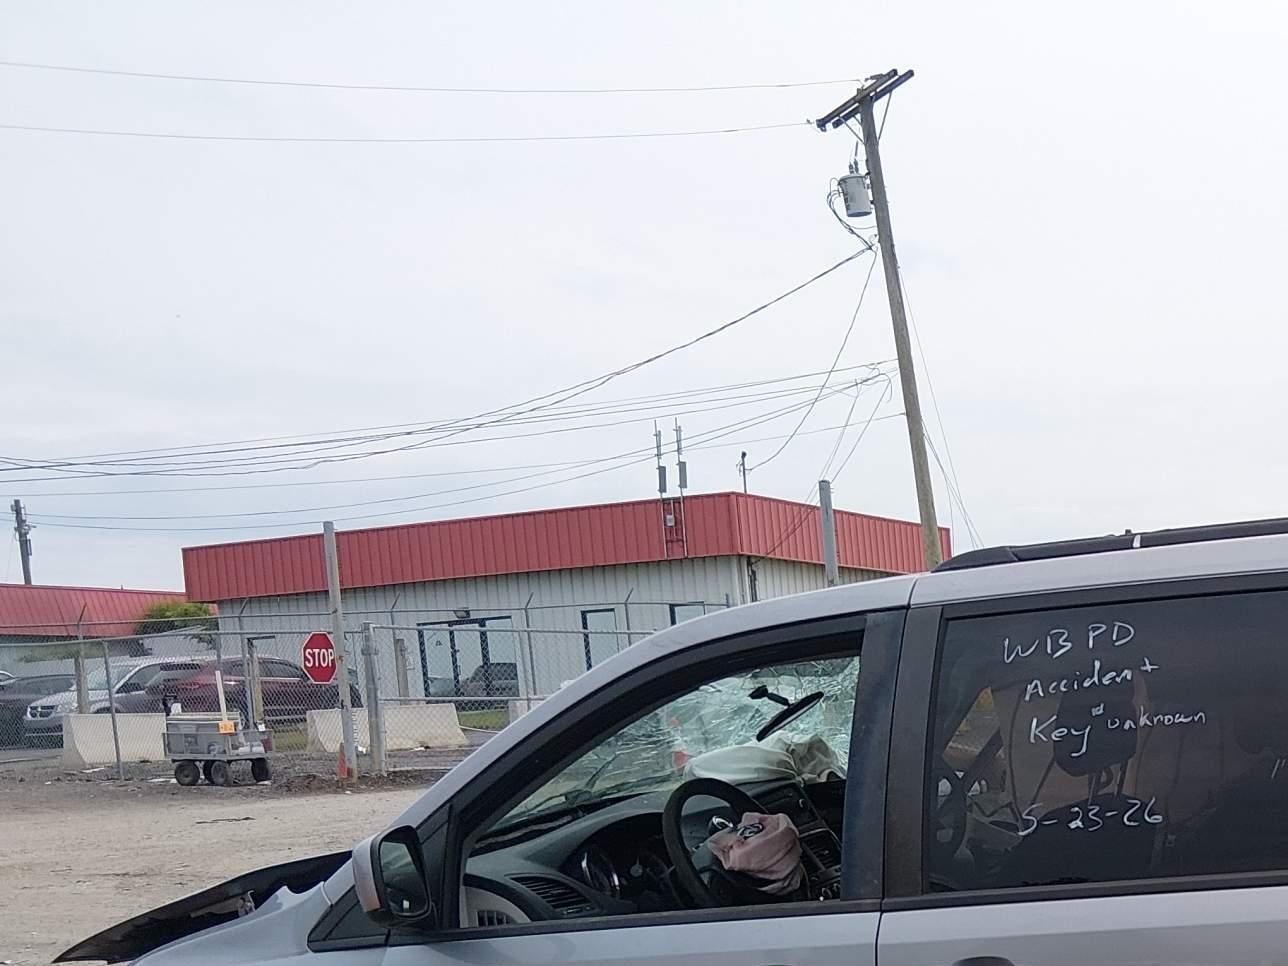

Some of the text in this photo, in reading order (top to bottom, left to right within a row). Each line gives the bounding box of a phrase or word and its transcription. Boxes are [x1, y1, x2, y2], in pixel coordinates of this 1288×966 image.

[304, 648, 335, 668] STOP
[1024, 656, 1161, 702] Accident
[1029, 714, 1092, 757] Key
[1017, 796, 1164, 837] 5-23-26
